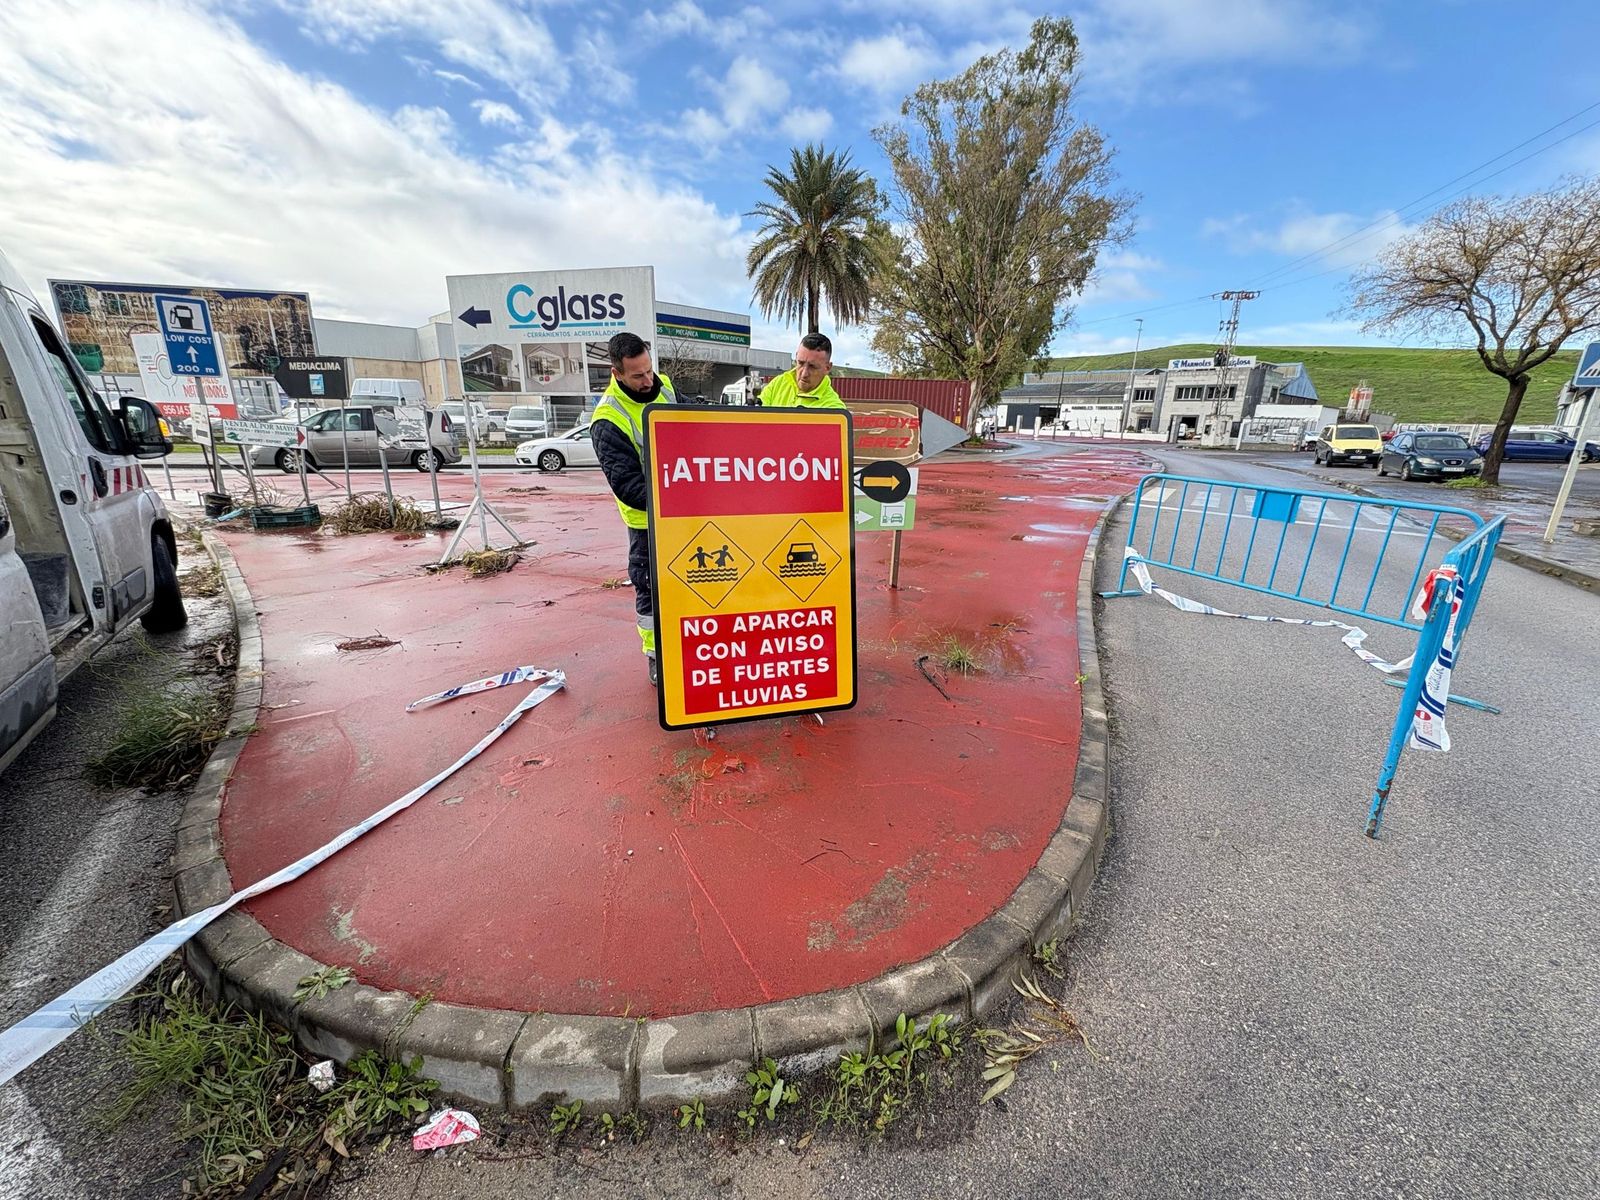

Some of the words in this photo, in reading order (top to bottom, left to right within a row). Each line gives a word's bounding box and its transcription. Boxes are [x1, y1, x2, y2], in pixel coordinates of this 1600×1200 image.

[506, 284, 626, 331] Cglass
[165, 334, 185, 343] LOW
[189, 335, 212, 344] COST
[176, 364, 200, 373] 200
[288, 361, 342, 371] MEDIACLIMA
[224, 420, 248, 428] VENTA
[662, 453, 839, 488] ¡ATENCIÓN!
[683, 617, 718, 637] NO
[733, 609, 833, 633] APARCAR
[695, 640, 747, 661] CON
[759, 633, 824, 656] AVISO
[692, 667, 722, 687] DE
[734, 656, 830, 682] FUERTES
[718, 683, 808, 708] LLUVIAS
